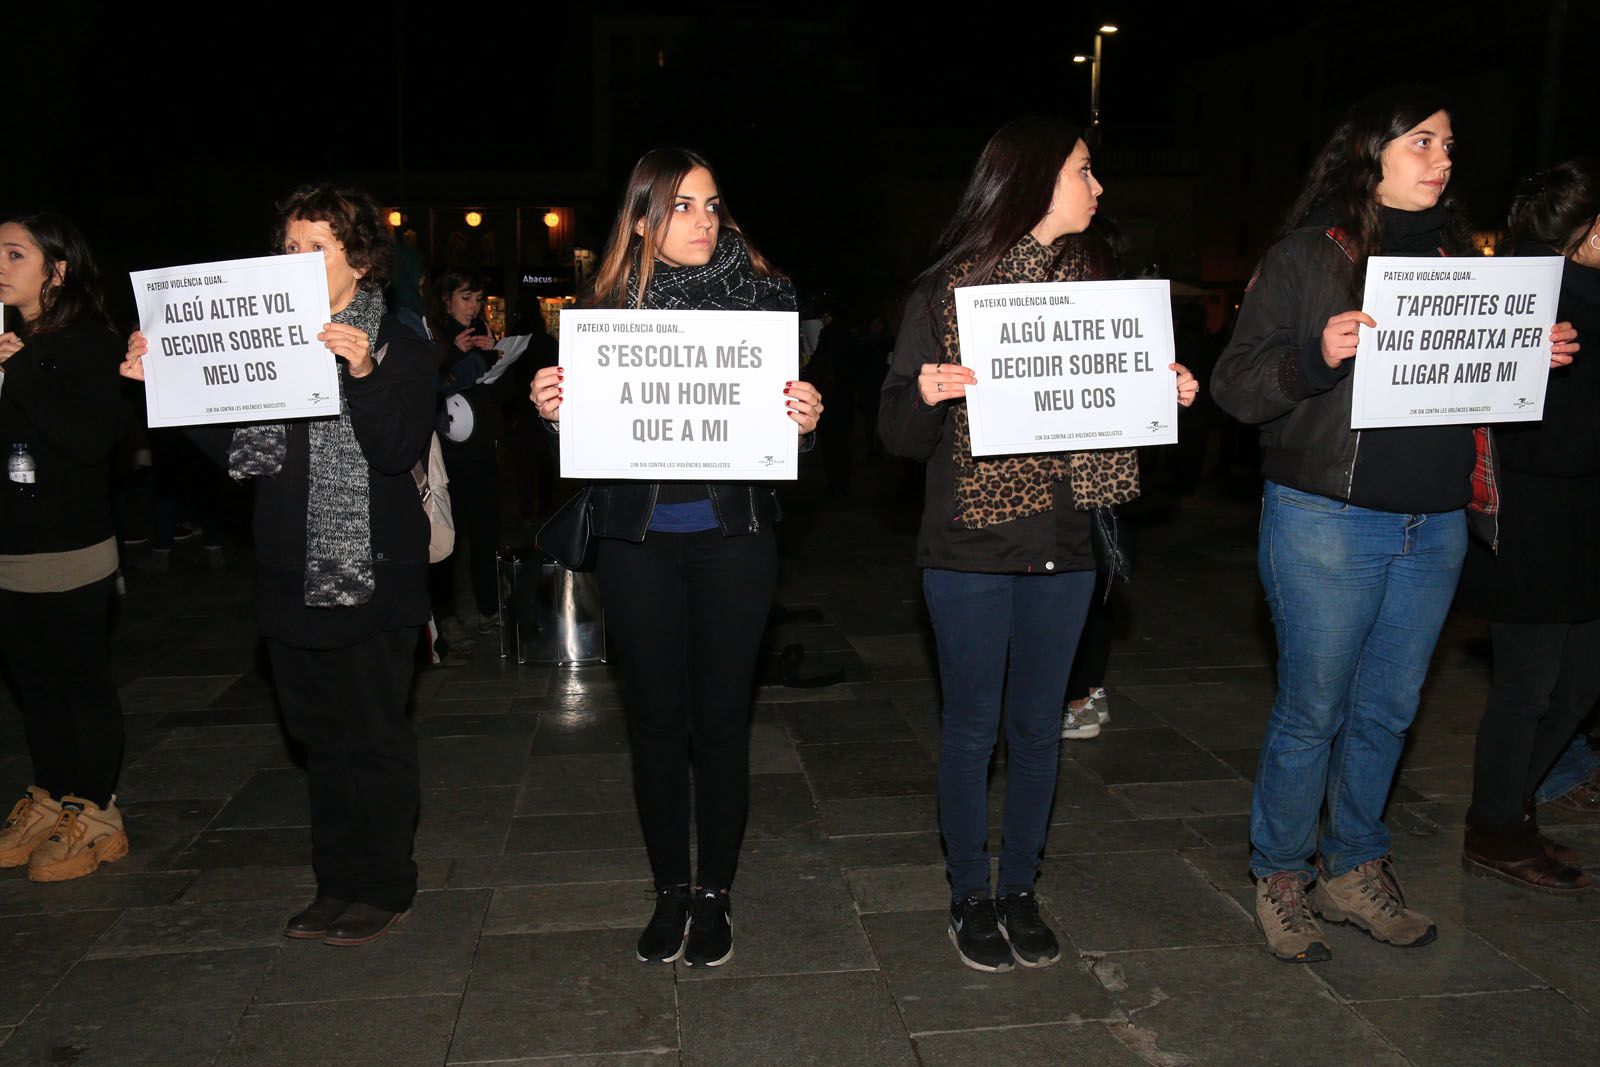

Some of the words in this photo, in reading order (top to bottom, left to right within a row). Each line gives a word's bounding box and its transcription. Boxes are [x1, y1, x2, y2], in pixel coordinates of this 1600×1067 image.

[147, 282, 169, 292] PATEIXO
[170, 277, 203, 289] VIOLÈNCIA
[523, 275, 552, 283] Abacus
[1384, 271, 1414, 280] PATEIXO
[1416, 269, 1451, 280] VIOLÈNCIA
[165, 296, 204, 324] ALGÚ
[210, 295, 258, 320] ALTRE
[263, 292, 295, 314] VOL
[974, 298, 1007, 308] PATEIXO
[1009, 295, 1047, 307] VIOLÈNCIA
[1504, 294, 1536, 316] QUE
[577, 324, 610, 333] PATEIXO
[613, 321, 653, 333] VIOLÈNCIA
[1000, 316, 1045, 344] ALGÚ
[1052, 319, 1105, 342] ALTRE
[1111, 318, 1144, 339] VOL
[1377, 330, 1414, 351] VAIG
[1420, 329, 1506, 350] BORRATXA
[1511, 327, 1543, 348] PER
[161, 333, 225, 357] DECIDIR
[230, 328, 284, 350] SOBRE
[288, 325, 309, 345] EL
[716, 340, 762, 369] MÉS
[991, 355, 1063, 379] DECIDIR
[1070, 353, 1127, 375] SOBRE
[1135, 352, 1154, 372] EL
[203, 365, 240, 386] MEU
[244, 361, 277, 382] COS
[1392, 364, 1449, 386] LLIGAR
[1454, 363, 1491, 384] AMB
[1496, 361, 1518, 382] MI
[620, 382, 633, 404] A
[641, 382, 670, 404] UN
[678, 382, 741, 405] HOME
[1034, 390, 1074, 412] MEU
[1081, 388, 1116, 409] COS
[633, 419, 673, 443] QUE
[681, 420, 694, 442] A
[702, 420, 728, 442] MI
